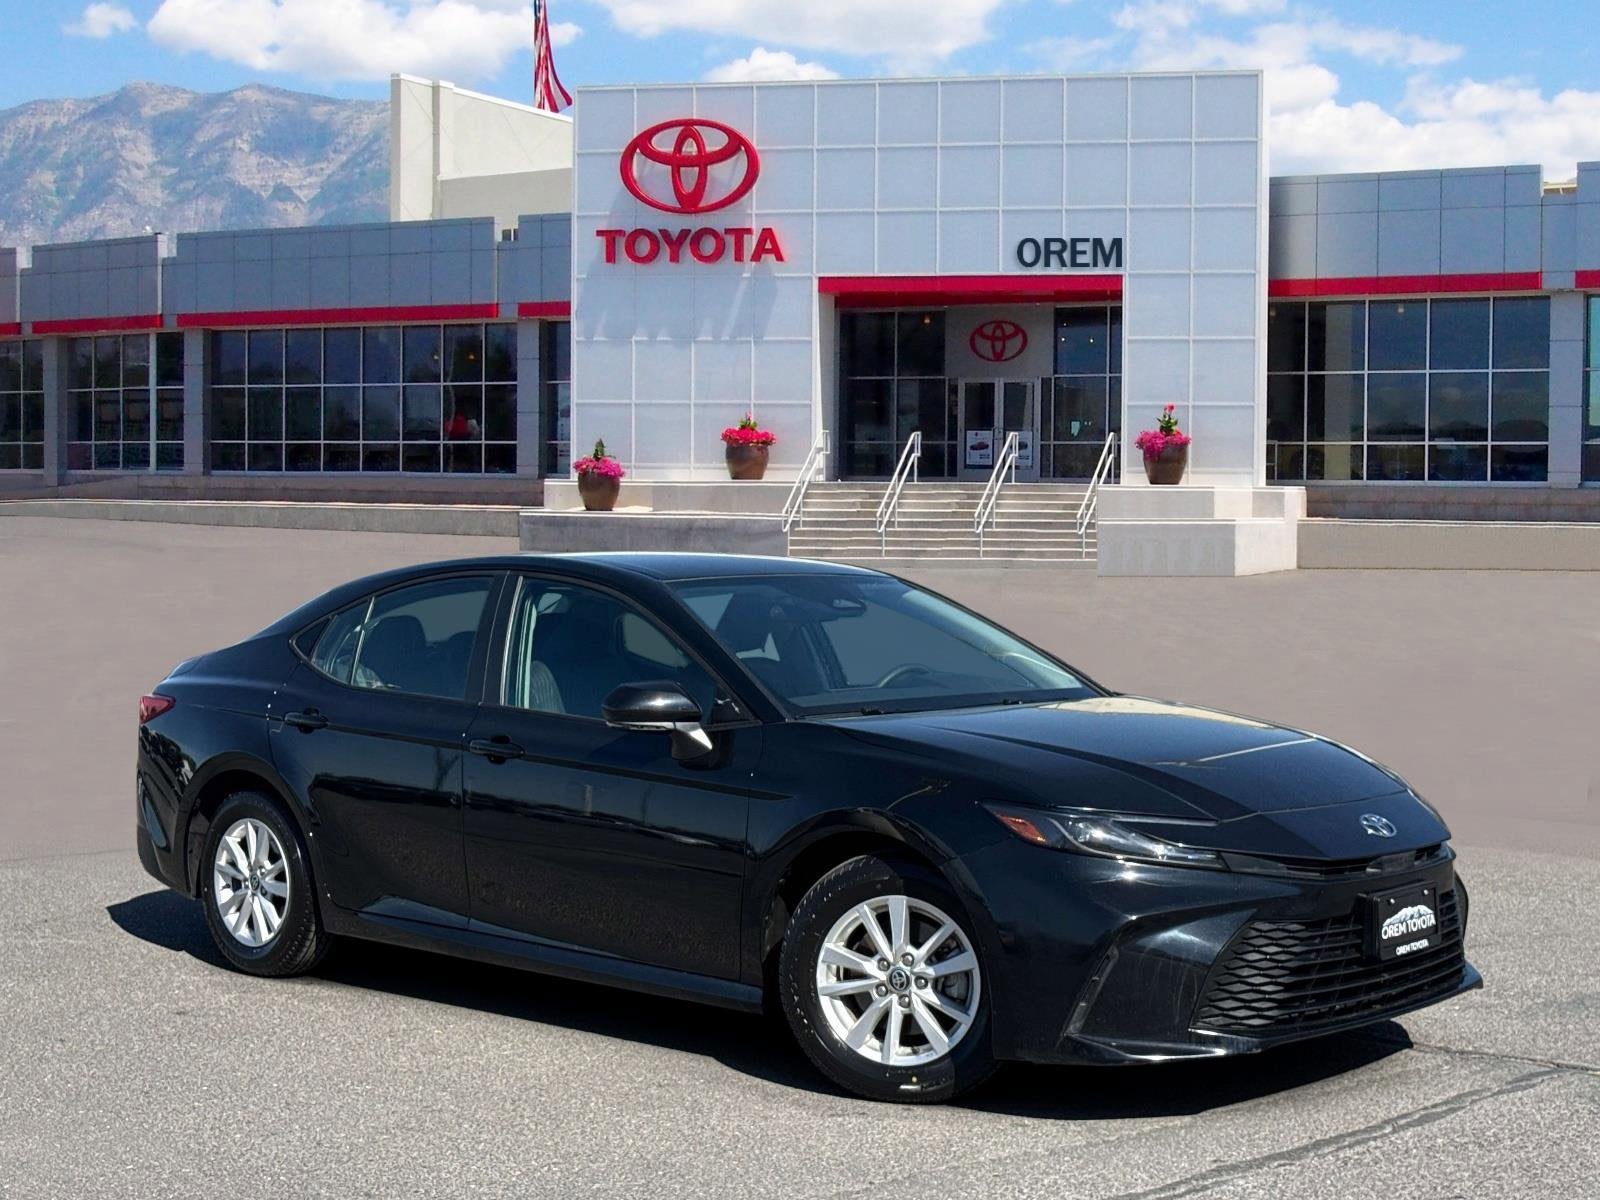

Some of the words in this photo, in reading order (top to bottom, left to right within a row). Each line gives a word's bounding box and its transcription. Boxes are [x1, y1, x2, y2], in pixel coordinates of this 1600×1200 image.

[596, 227, 784, 263] TOYOTA
[1016, 237, 1123, 268] OREM
[1381, 921, 1407, 939] OREM
[1407, 914, 1436, 932] TOYOTA
[1395, 944, 1410, 956] OREM
[1410, 939, 1429, 951] TOYOTA
